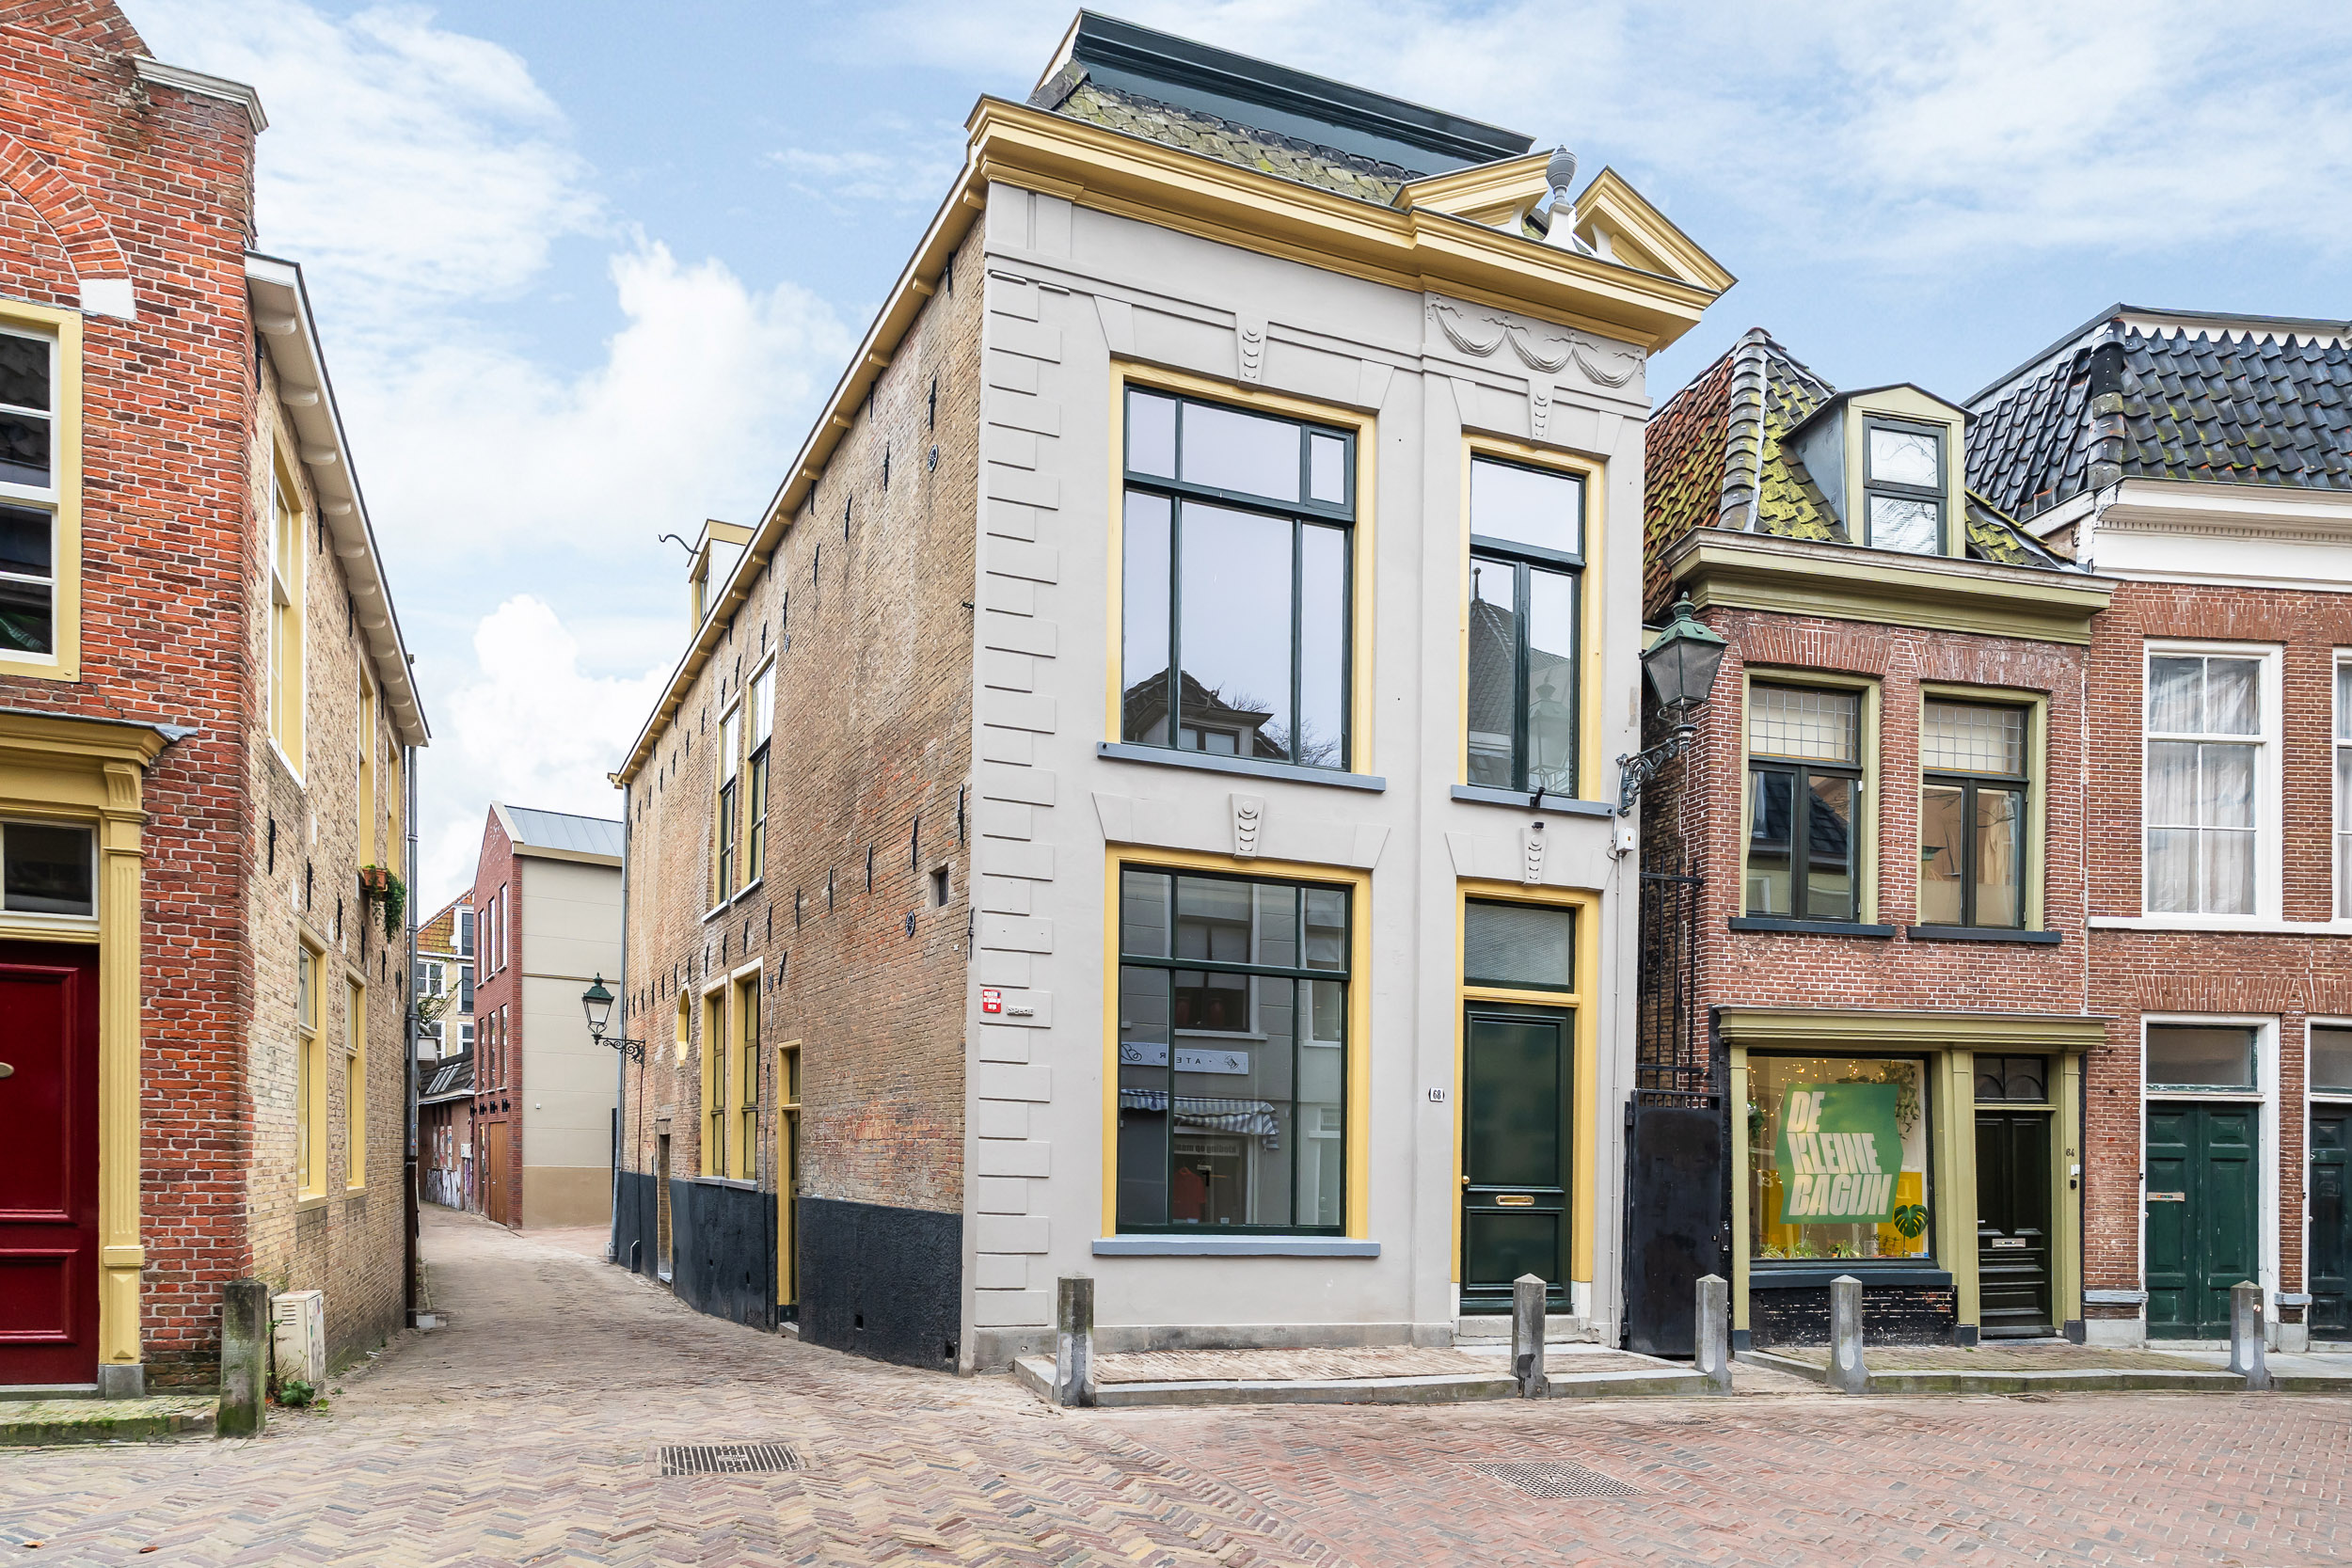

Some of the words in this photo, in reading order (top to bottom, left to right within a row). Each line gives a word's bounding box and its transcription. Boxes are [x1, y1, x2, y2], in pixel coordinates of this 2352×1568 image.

[1433, 1089, 1441, 1100] 68
[1787, 1091, 1825, 1132] DE
[1787, 1132, 1882, 1174] KLEINE
[2066, 1148, 2075, 1157] 64
[1788, 1173, 1892, 1216] BAGIJN
